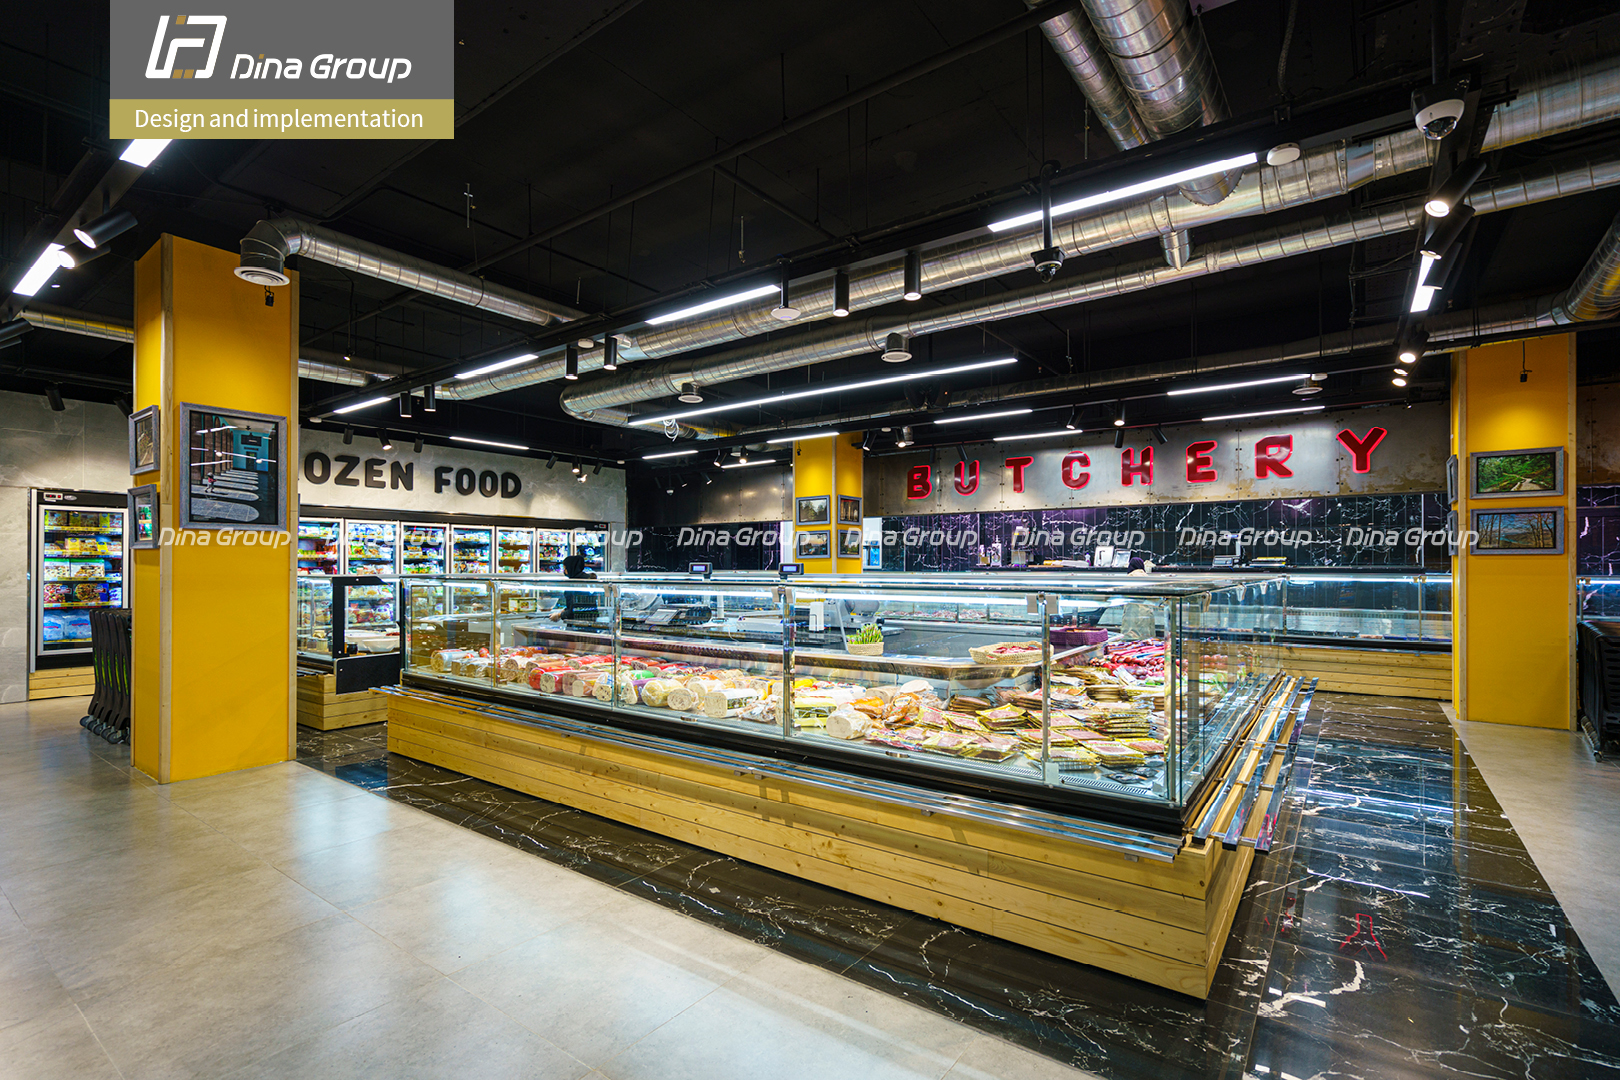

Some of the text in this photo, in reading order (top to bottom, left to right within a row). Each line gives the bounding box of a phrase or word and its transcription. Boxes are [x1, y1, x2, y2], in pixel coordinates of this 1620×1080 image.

[303, 451, 522, 498] OZEN FOOD
[906, 427, 1388, 499] BUTCHERY
